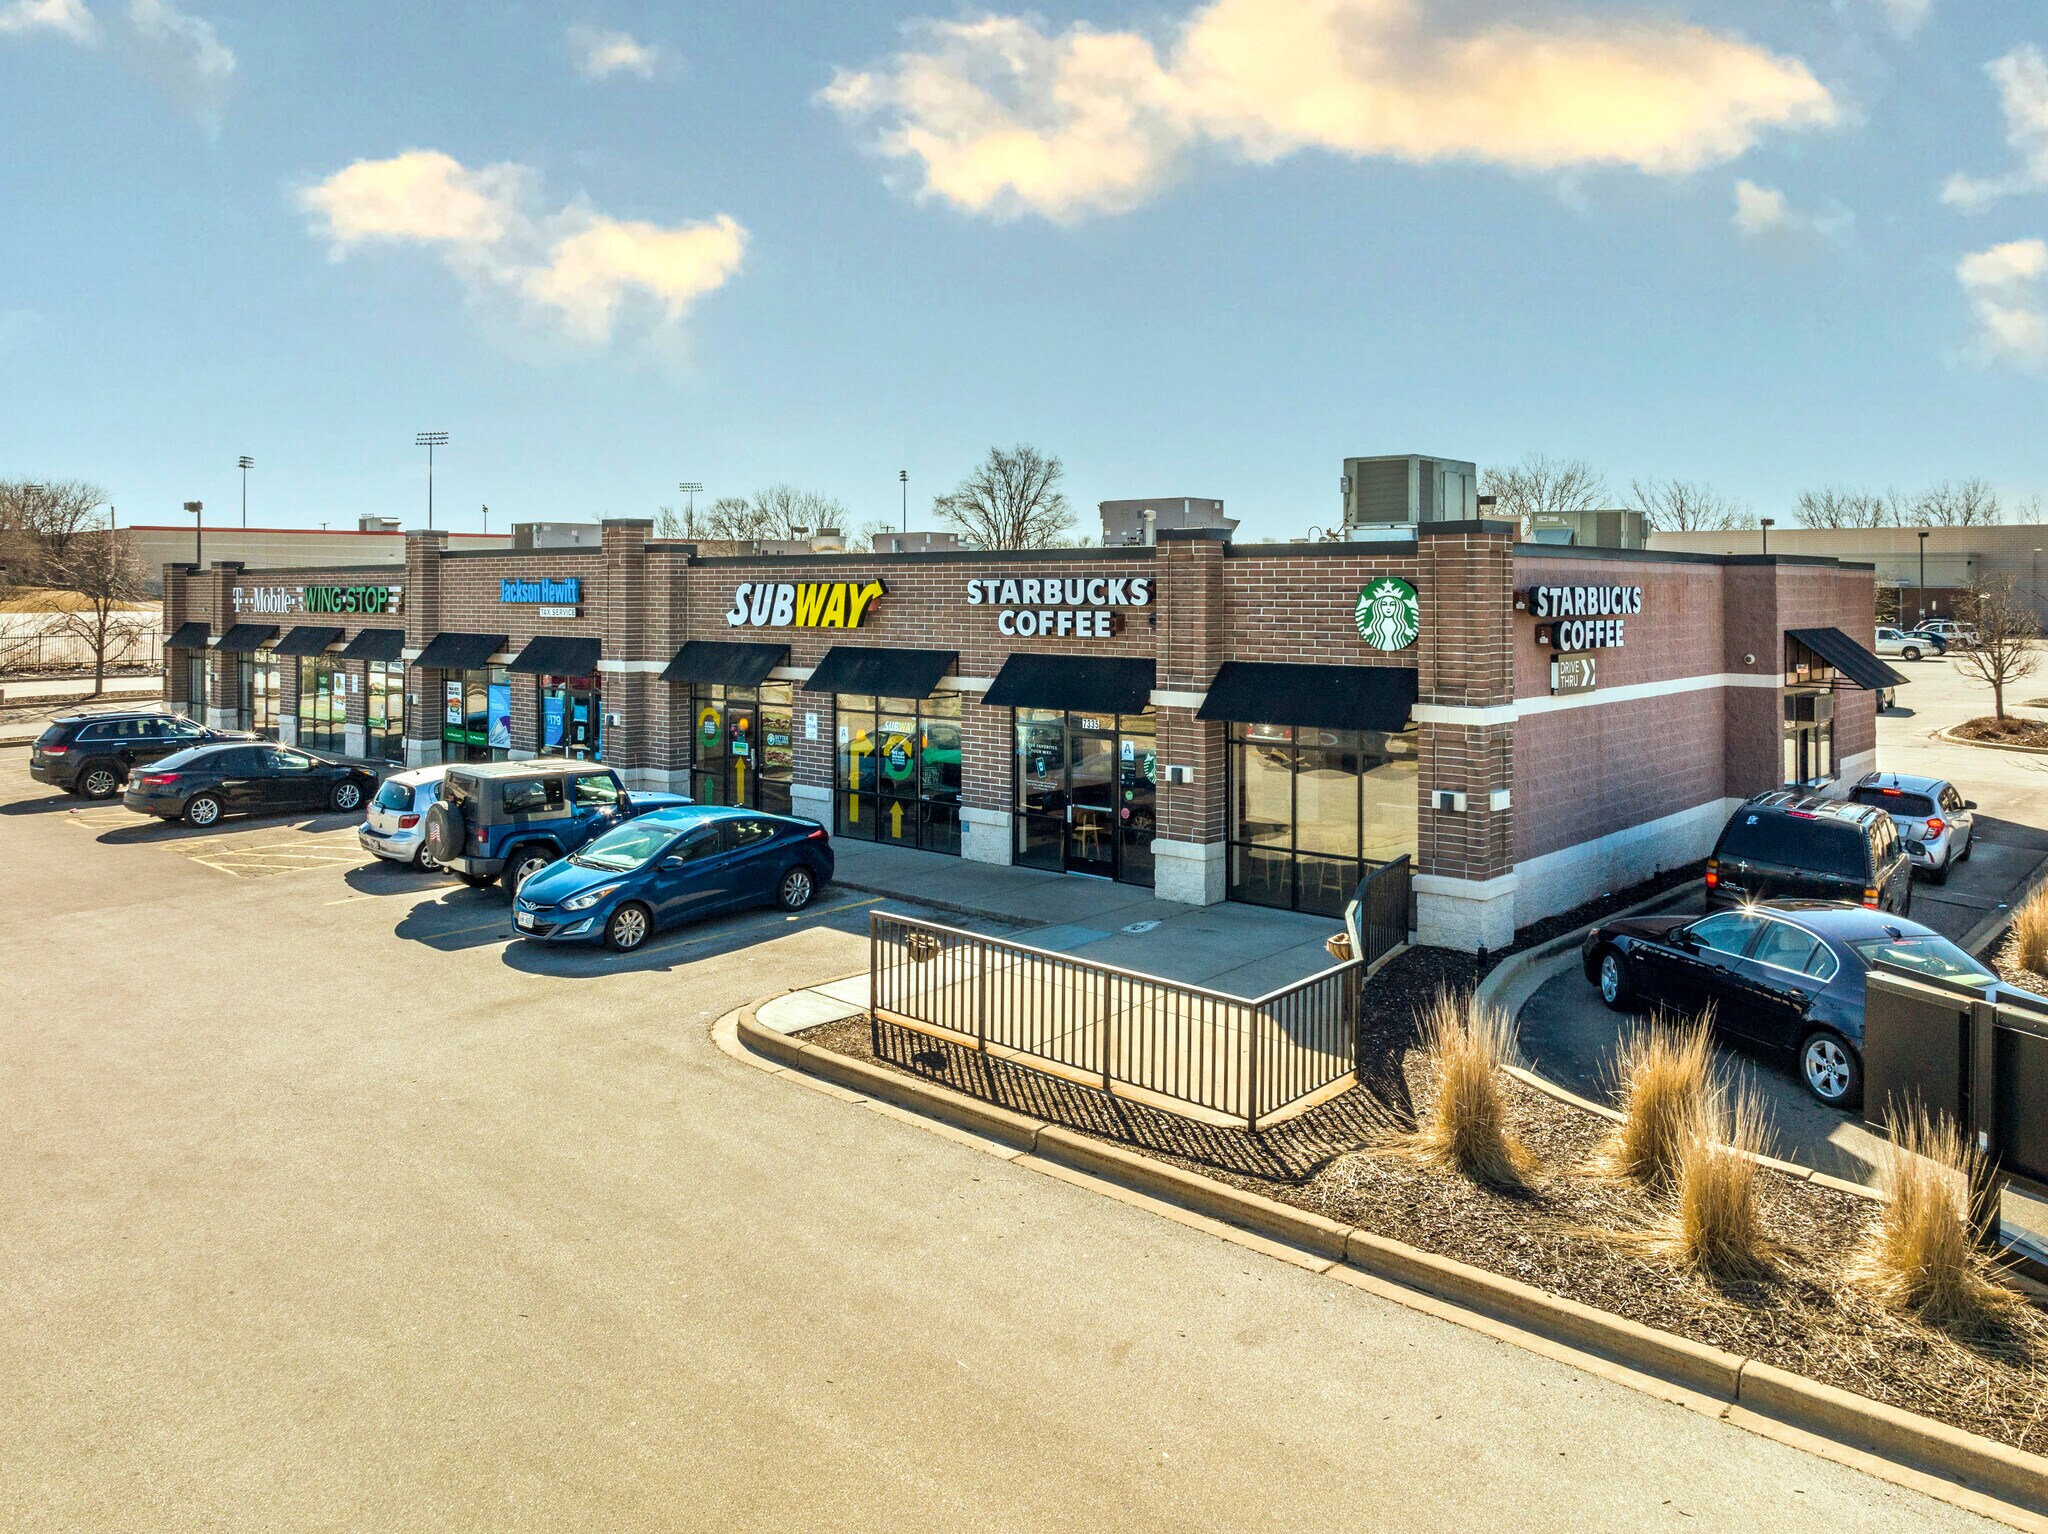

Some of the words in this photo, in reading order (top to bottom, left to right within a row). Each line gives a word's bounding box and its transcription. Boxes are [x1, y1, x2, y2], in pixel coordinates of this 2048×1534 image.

[500, 578, 541, 603] Jackson
[541, 578, 578, 603] Hewitt
[966, 577, 1151, 606] STARBUCKS
[726, 579, 885, 628] SUBWAY
[1536, 585, 1642, 618] STARBUCKS
[540, 608, 551, 616] TAX
[551, 608, 576, 616] SERVICE
[998, 609, 1112, 638] COFFEE
[1559, 619, 1625, 652] COFFEE
[1559, 660, 1580, 675] DRIVE
[1560, 674, 1579, 688] THRU
[883, 721, 916, 733] SUBWAY
[1082, 719, 1100, 729] 7335
[1123, 743, 1132, 754] A
